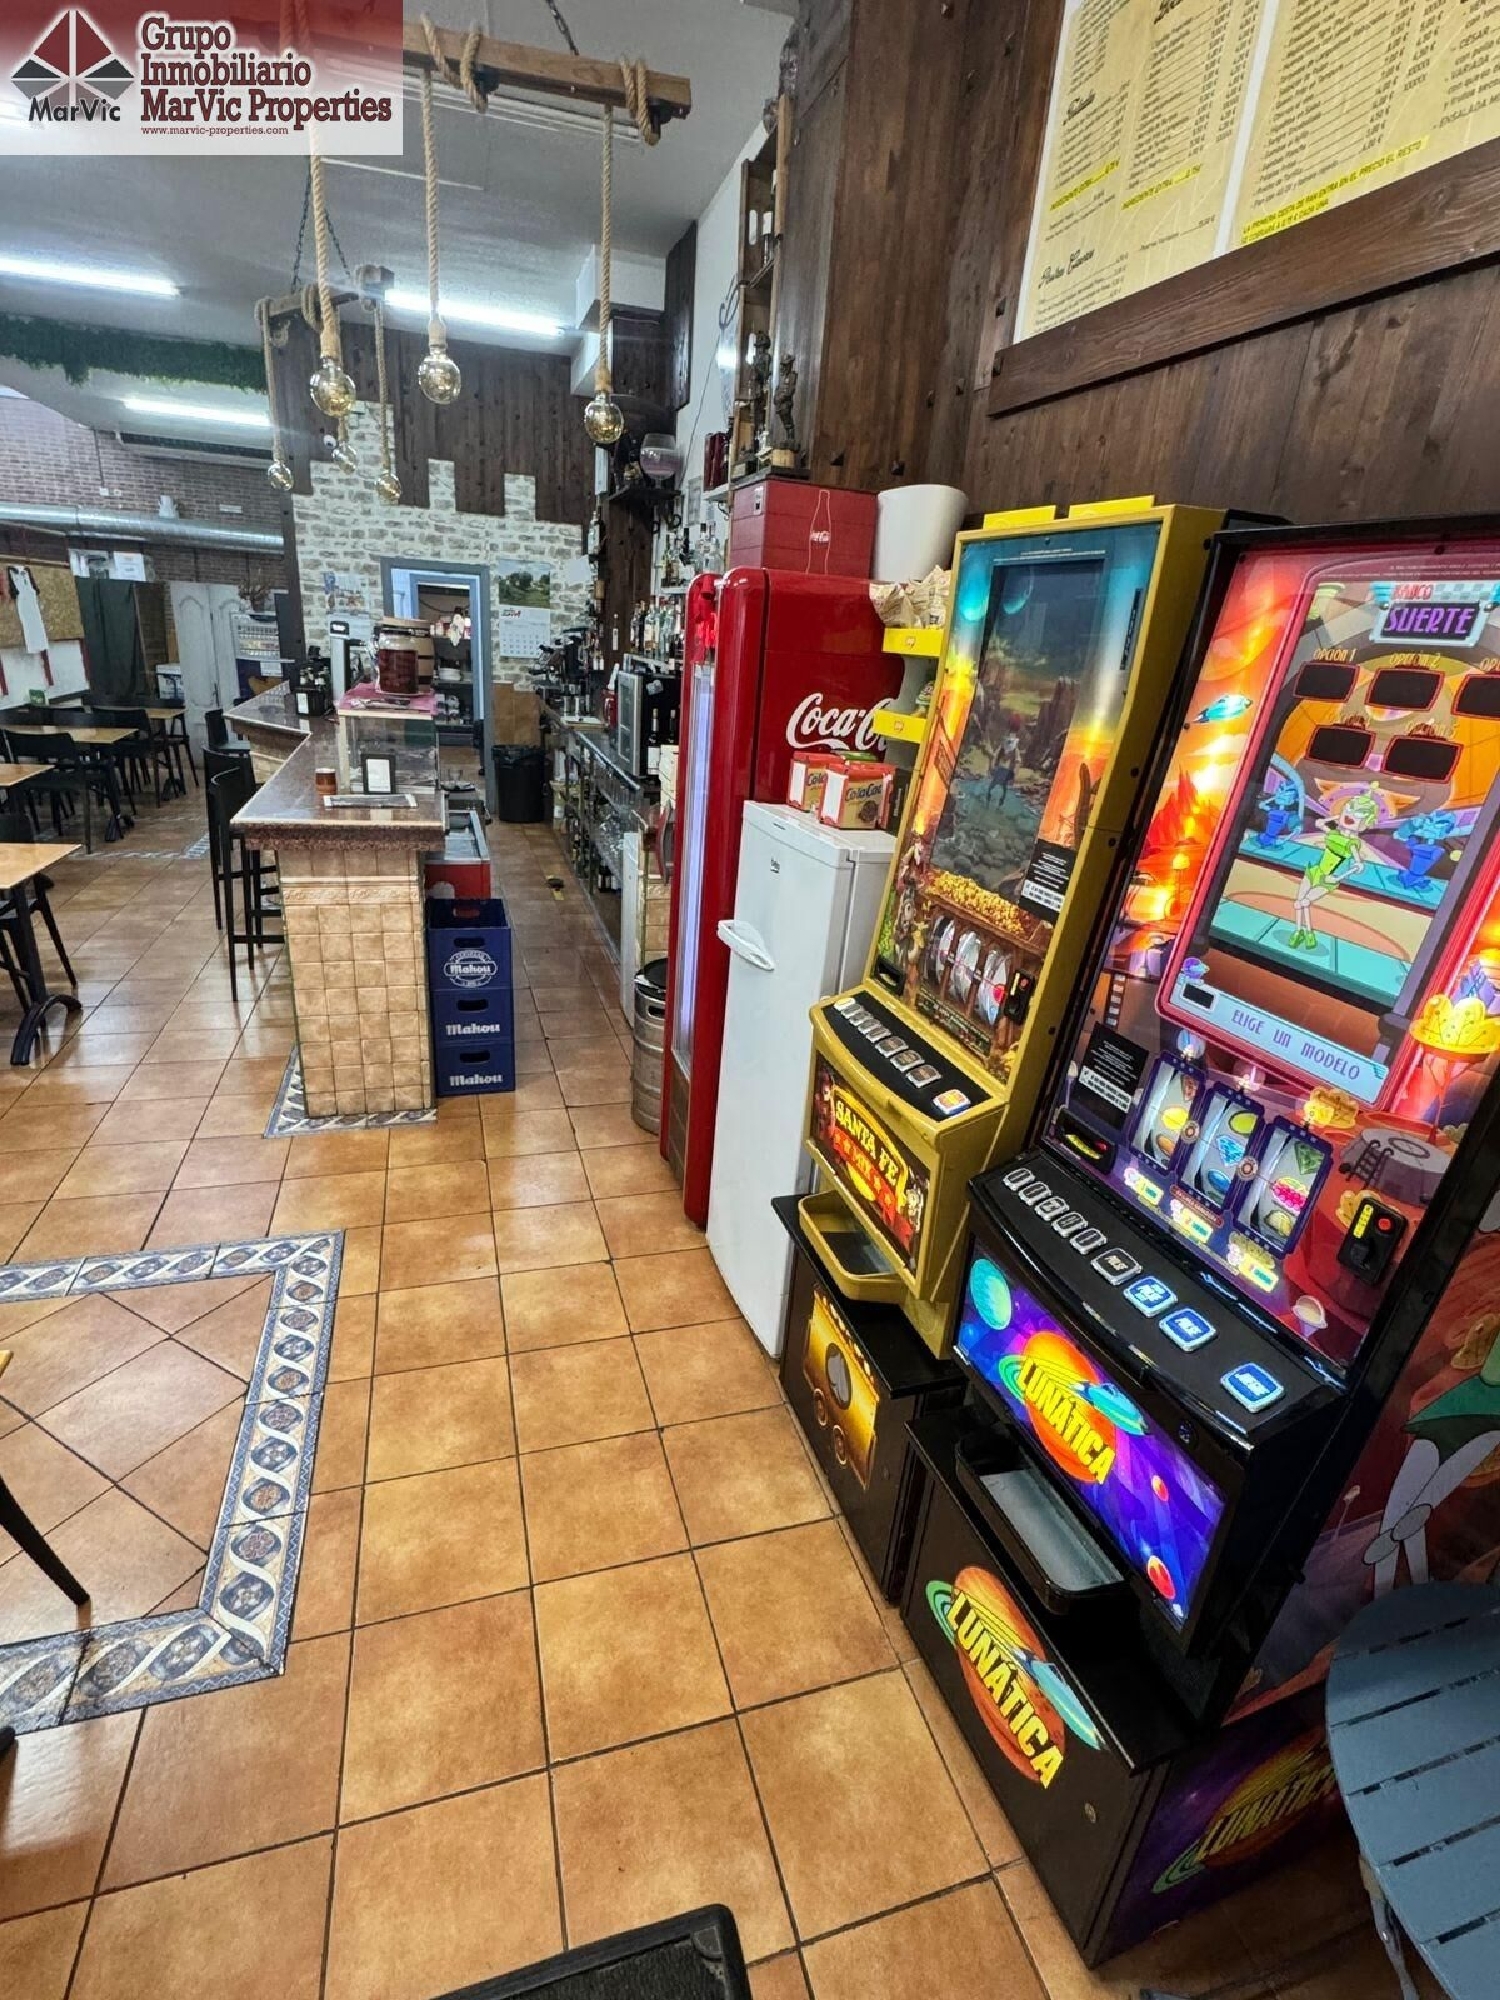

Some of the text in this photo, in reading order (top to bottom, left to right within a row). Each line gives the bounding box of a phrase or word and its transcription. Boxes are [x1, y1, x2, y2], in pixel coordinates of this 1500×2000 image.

[1384, 607, 1476, 634] SUERTE
[786, 692, 893, 751] Coca-C
[449, 963, 491, 975] Mahou
[445, 1023, 501, 1036] Mahou
[1231, 1008, 1361, 1081] ELIGE UN MODELO
[449, 1074, 504, 1087] Mahou
[835, 1100, 877, 1160] SANTA
[879, 1147, 900, 1187] FE
[1016, 1356, 1116, 1485] LUNÁTICA
[947, 1591, 1064, 1789] LUNÁTICA
